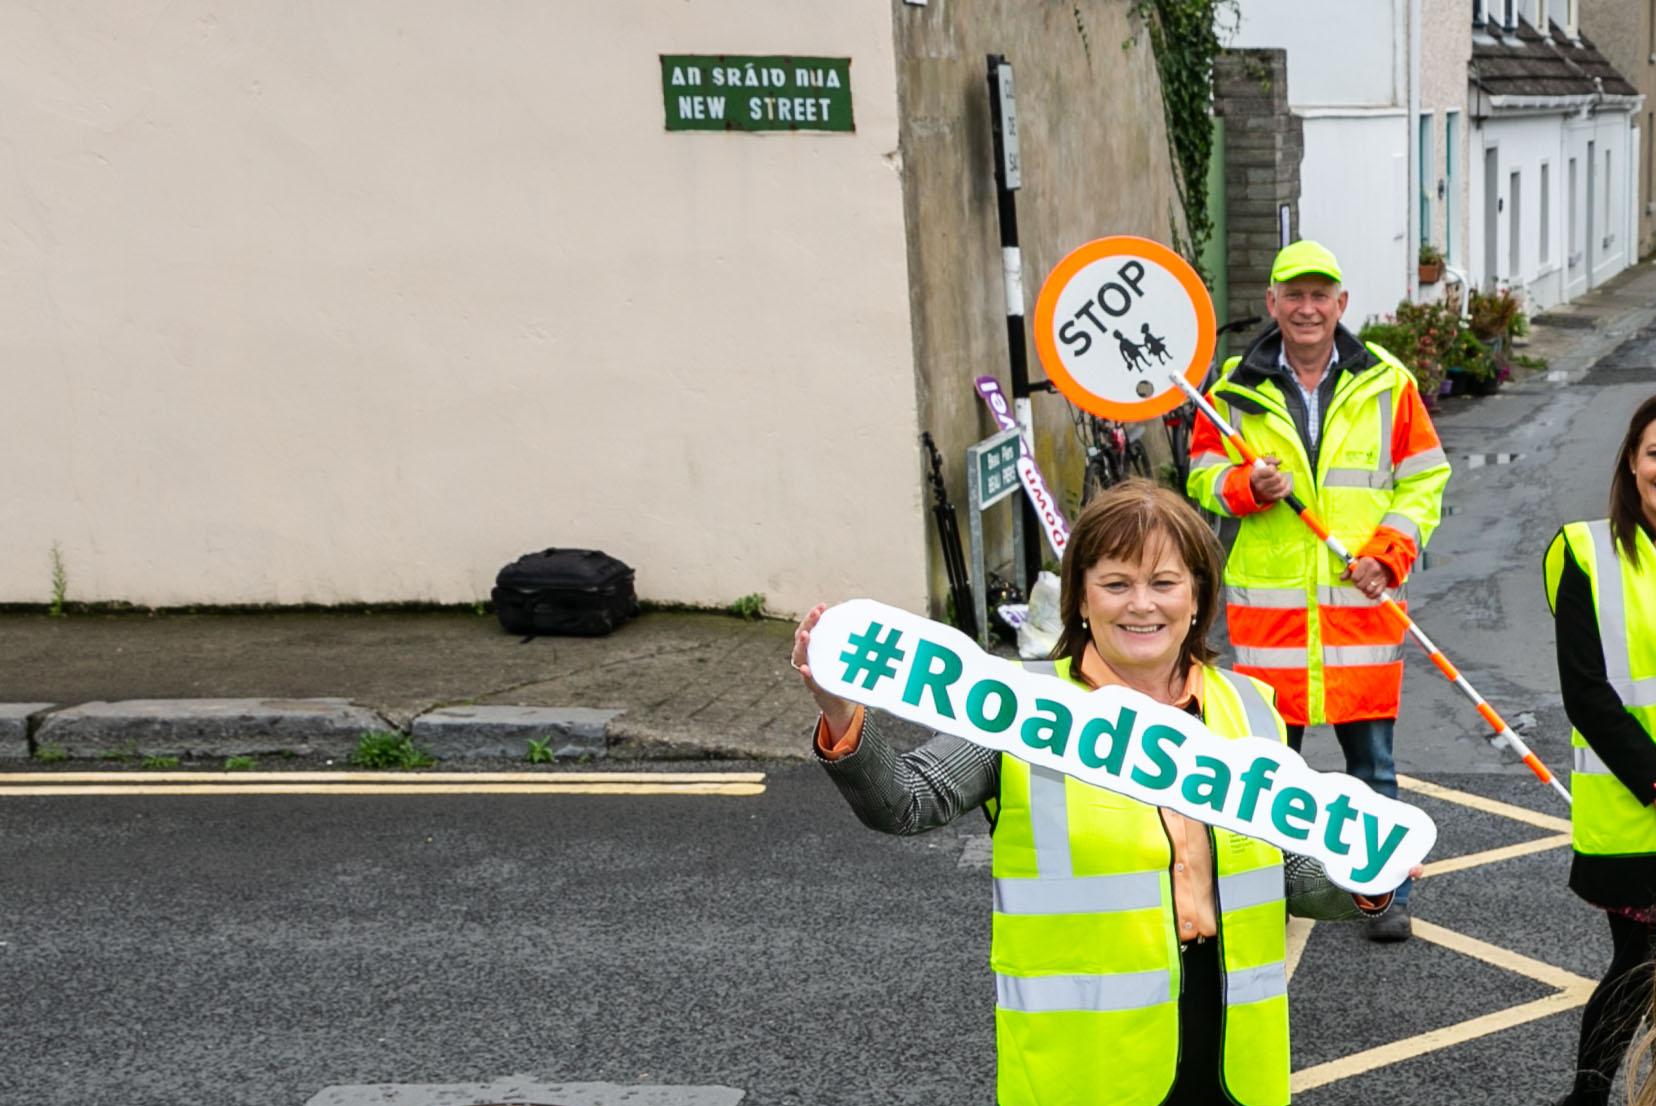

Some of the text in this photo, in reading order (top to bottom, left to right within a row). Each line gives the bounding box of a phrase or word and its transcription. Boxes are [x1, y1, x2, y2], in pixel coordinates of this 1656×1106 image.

[678, 96, 831, 121] NEW STREET
[1059, 260, 1145, 357] STOP
[839, 621, 1410, 883] #RoadSafety
